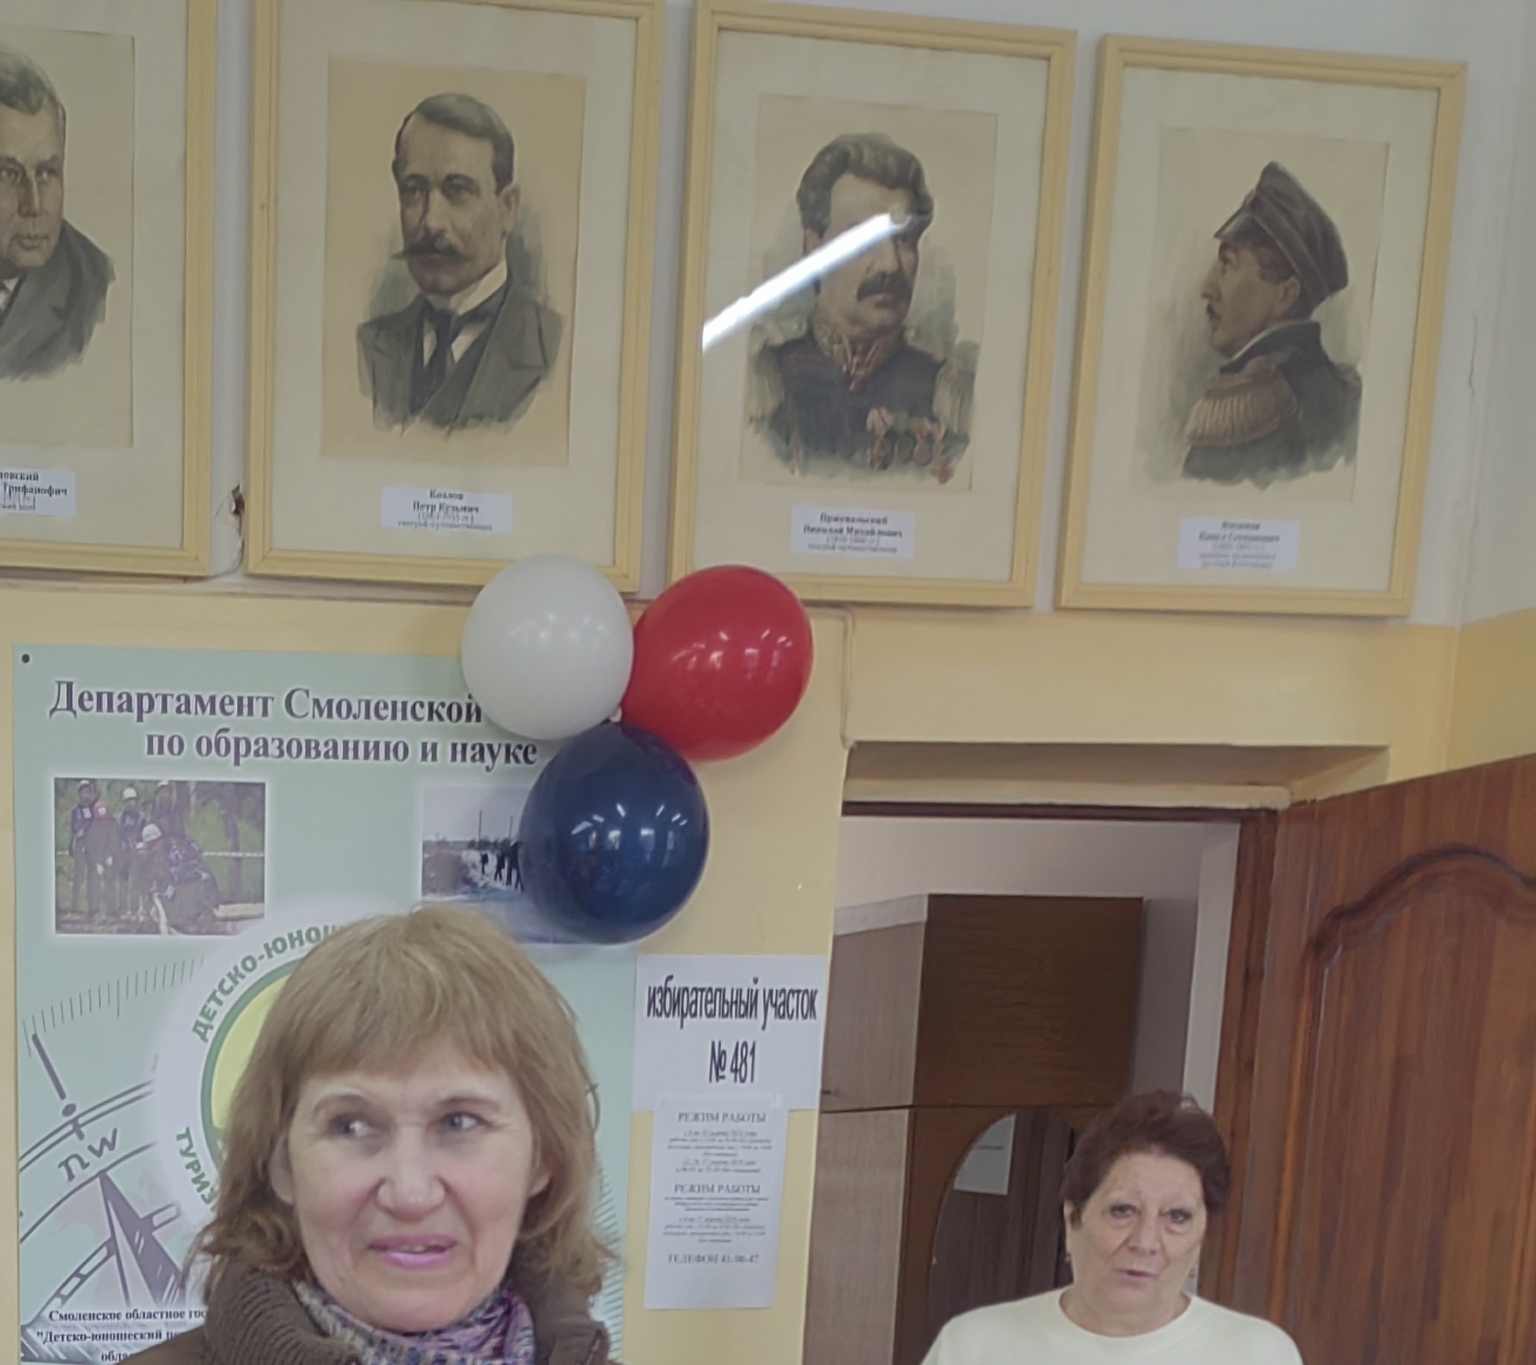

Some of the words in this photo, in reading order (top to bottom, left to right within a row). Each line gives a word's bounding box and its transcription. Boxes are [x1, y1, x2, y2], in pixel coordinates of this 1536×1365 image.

[49, 680, 275, 722] Департамент
[283, 686, 483, 724] Смоленской
[146, 733, 185, 758] по
[195, 727, 409, 767] образованию
[420, 739, 439, 763] и
[450, 739, 538, 773] науке
[647, 974, 759, 1030] избирательный
[761, 987, 819, 1031] участок
[709, 1040, 727, 1083] №
[729, 1040, 756, 1083] 481
[49, 1309, 122, 1322] Смоленское
[125, 1308, 186, 1321] областное
